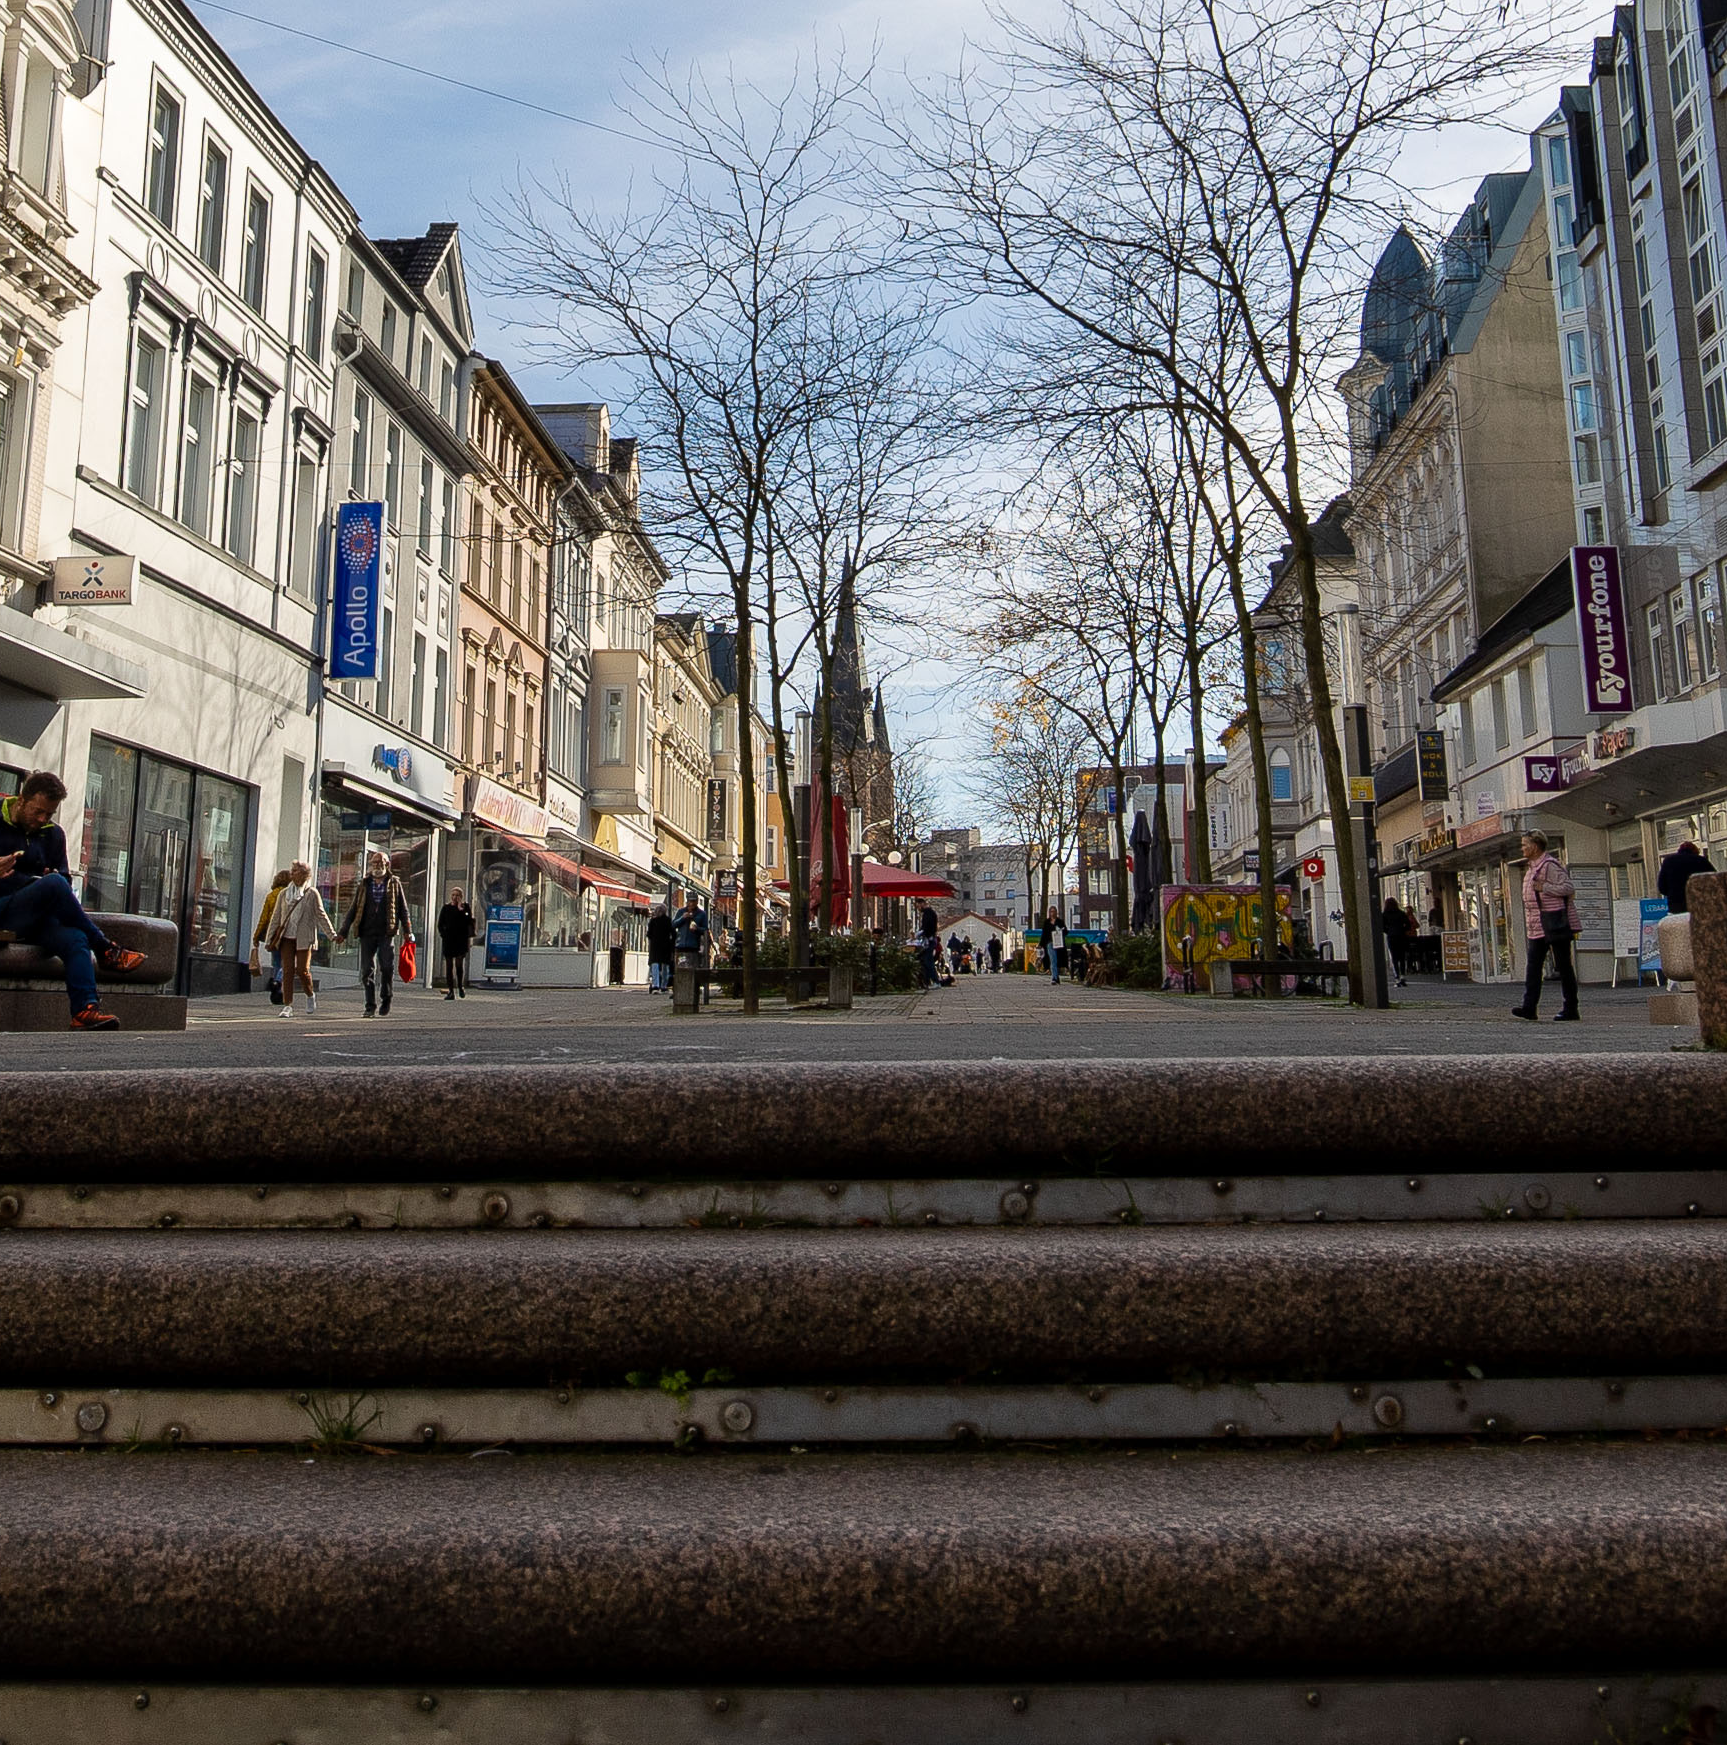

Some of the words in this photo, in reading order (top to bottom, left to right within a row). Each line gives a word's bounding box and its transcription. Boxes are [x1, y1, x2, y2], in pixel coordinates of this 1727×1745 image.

[58, 589, 127, 600] TARGOBANK
[343, 585, 372, 667] Apollo
[1587, 554, 1626, 690] yourfone
[1422, 752, 1442, 760] WOK
[1210, 815, 1218, 848] expert
